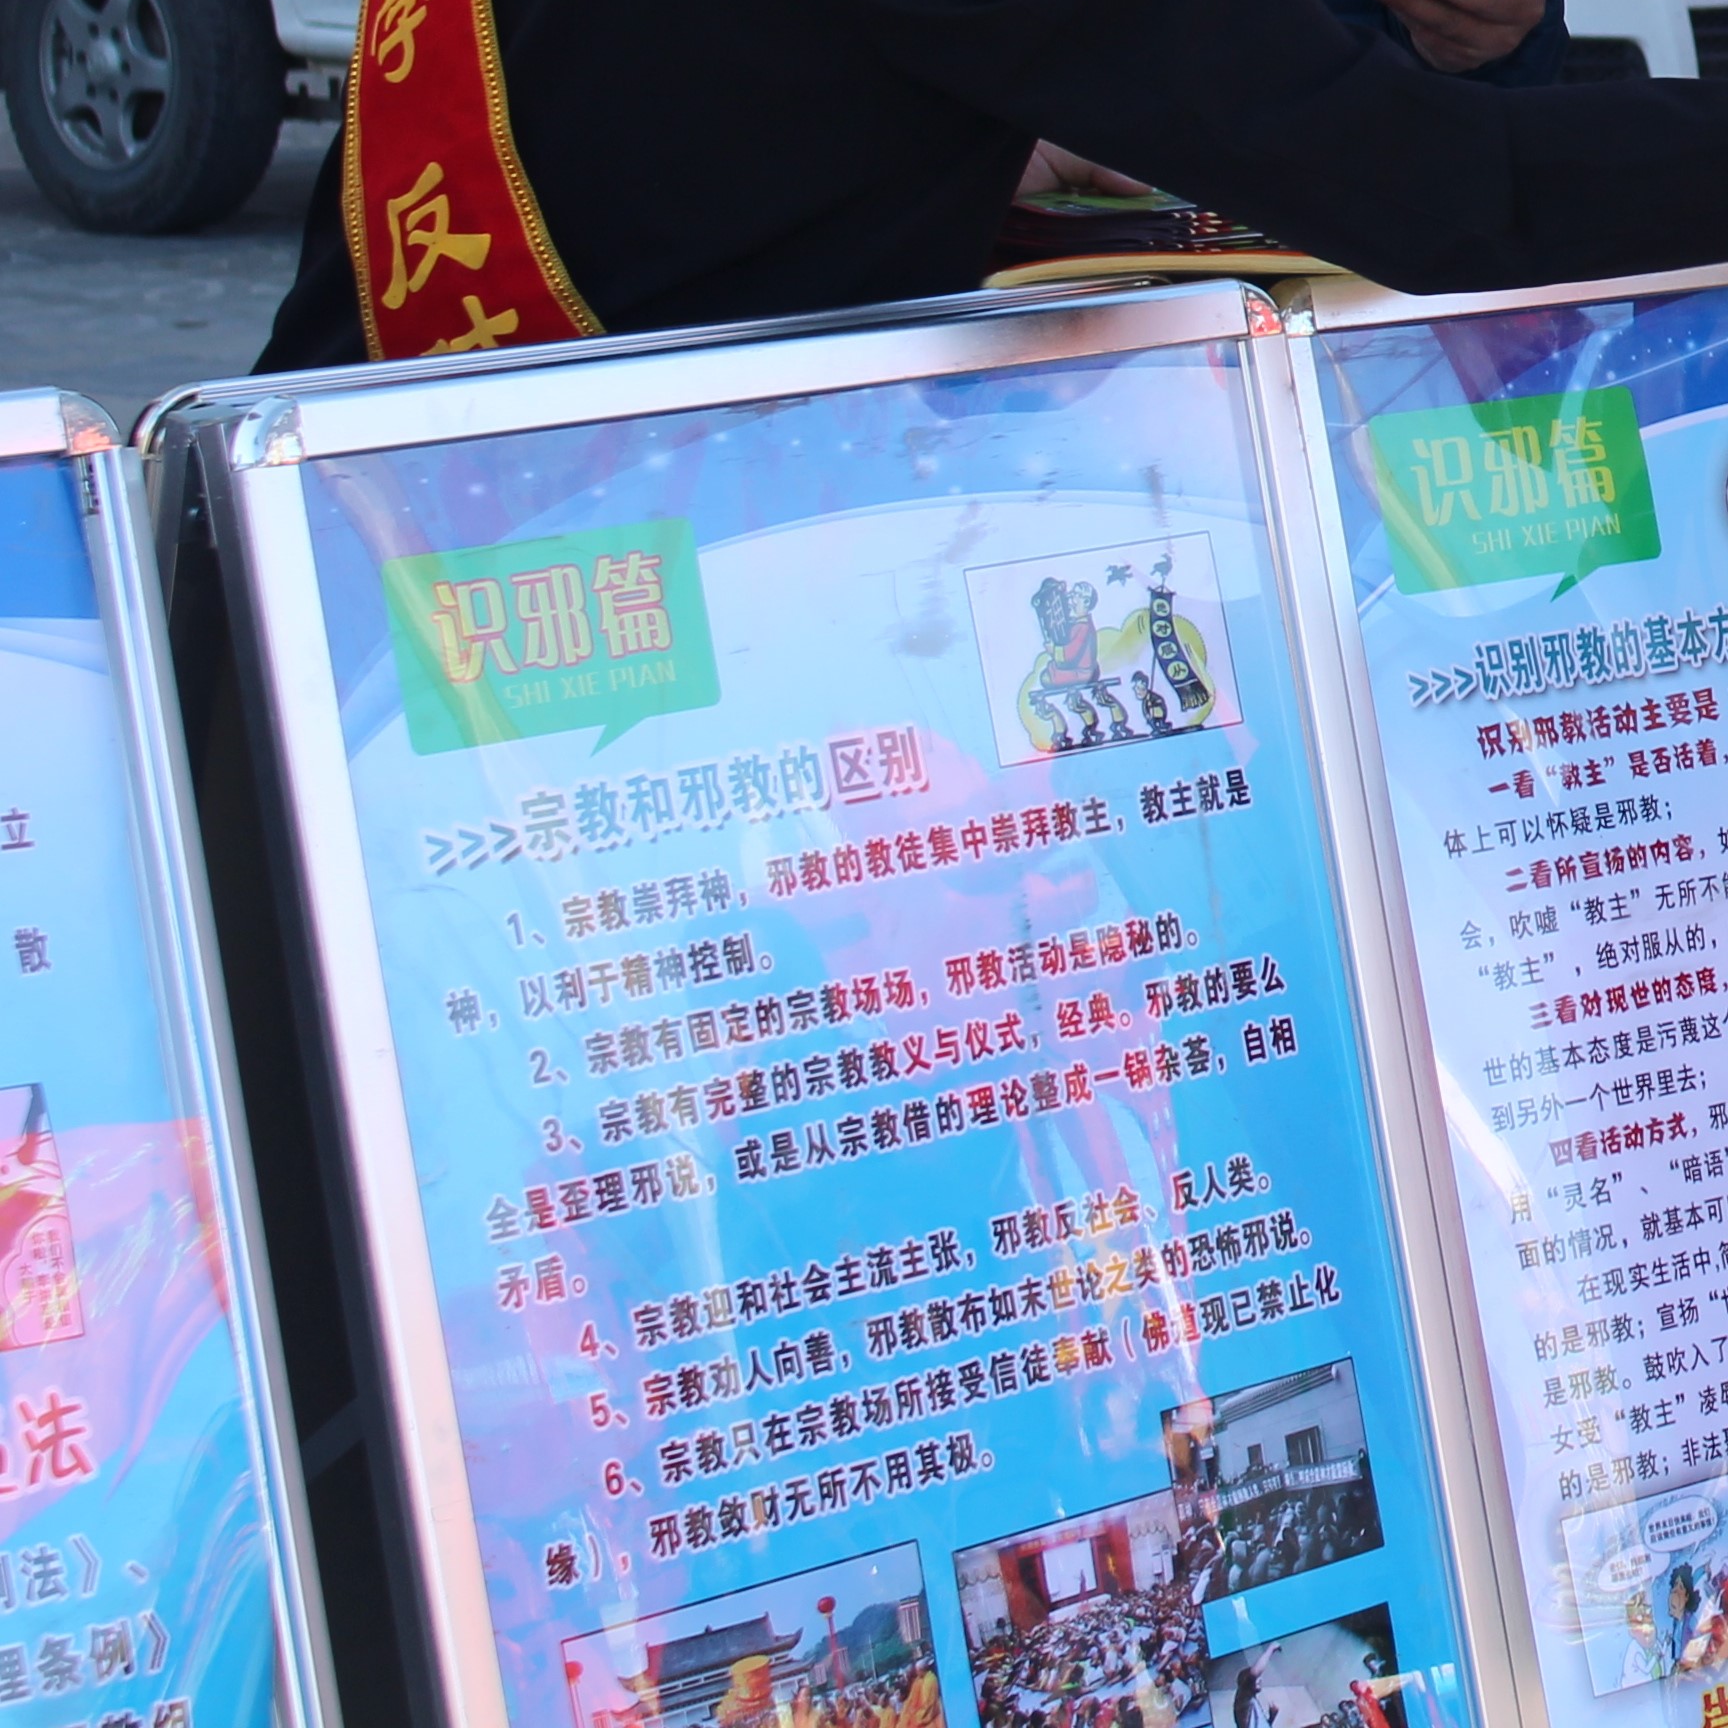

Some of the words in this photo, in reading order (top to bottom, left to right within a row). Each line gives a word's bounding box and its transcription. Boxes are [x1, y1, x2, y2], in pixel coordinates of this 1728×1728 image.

[1411, 417, 1618, 528] 识邪篇
[1470, 528, 1510, 555] SHI
[1518, 523, 1553, 547] XIE
[1559, 512, 1621, 542] PIAN
[425, 548, 678, 688] 识邪篇
[502, 680, 555, 709] SHI
[559, 671, 602, 699] XIE
[608, 657, 677, 690] PIAN
[518, 725, 927, 858] 宗教和邪教的区别
[14, 926, 52, 975] 散
[493, 1249, 587, 1314] 矛盾。
